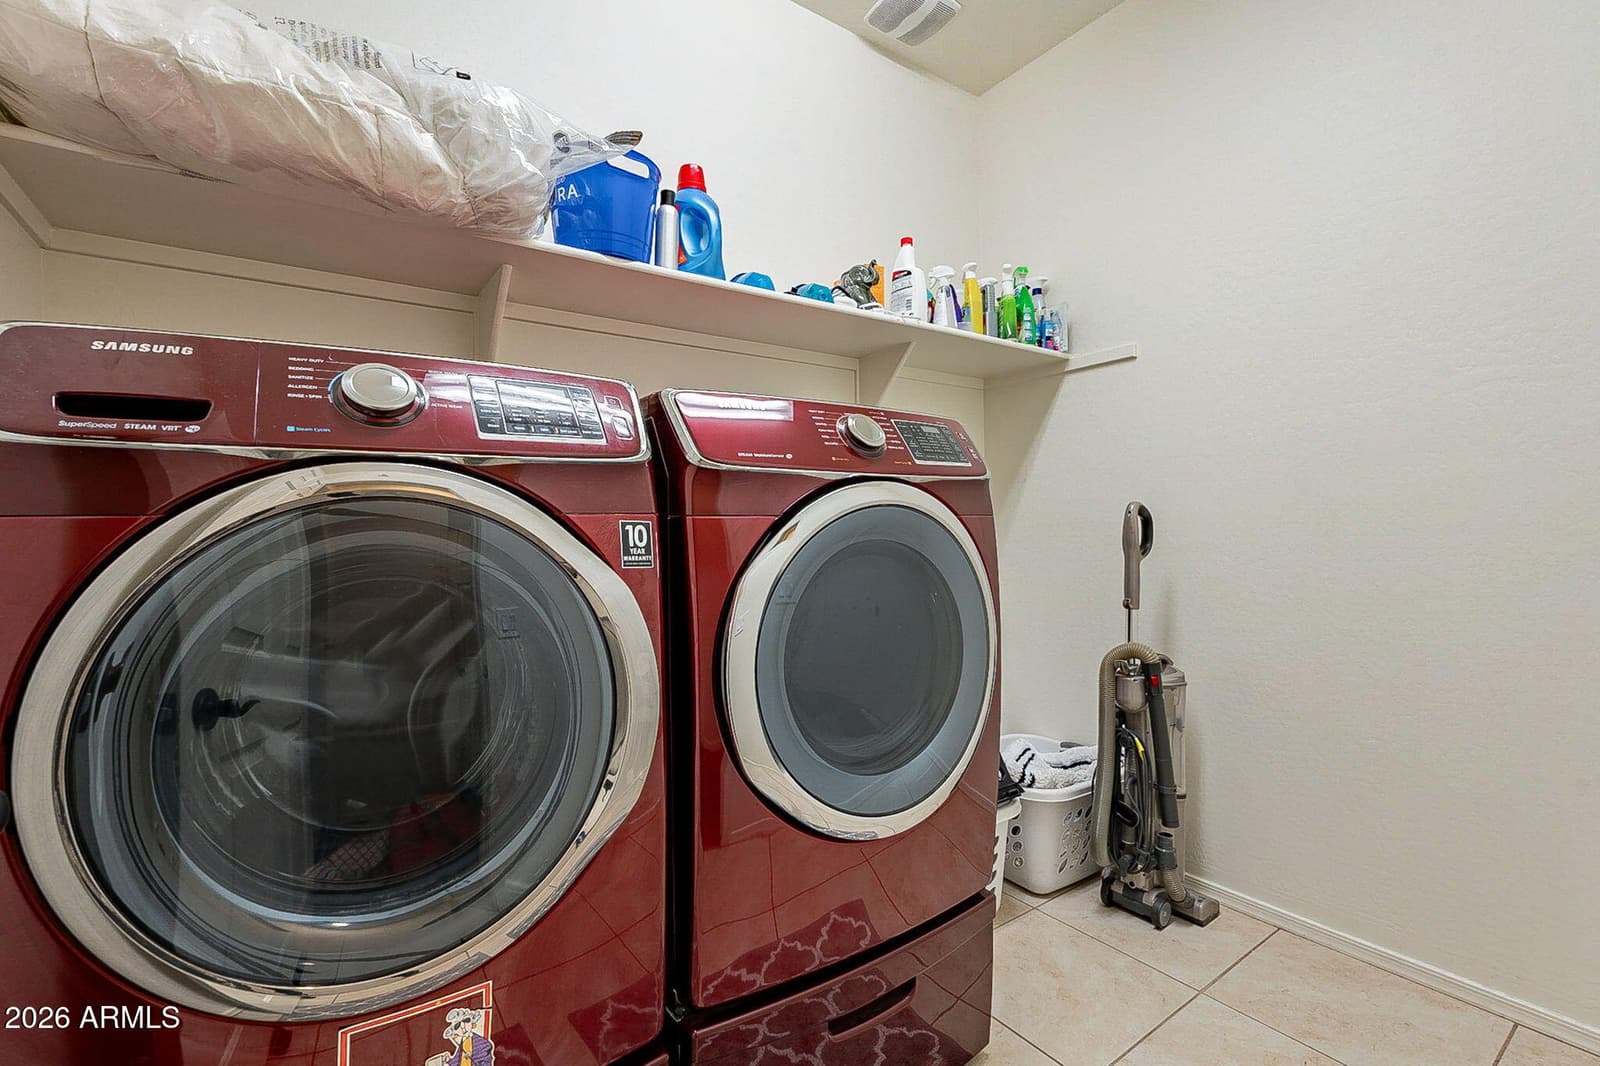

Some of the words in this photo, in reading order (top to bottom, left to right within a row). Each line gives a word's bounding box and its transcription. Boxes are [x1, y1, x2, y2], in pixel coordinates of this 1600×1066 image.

[91, 340, 194, 355] SAMSUNG
[58, 420, 117, 429] SuperSpeed
[124, 423, 157, 431] STEAM
[625, 524, 648, 547] 10
